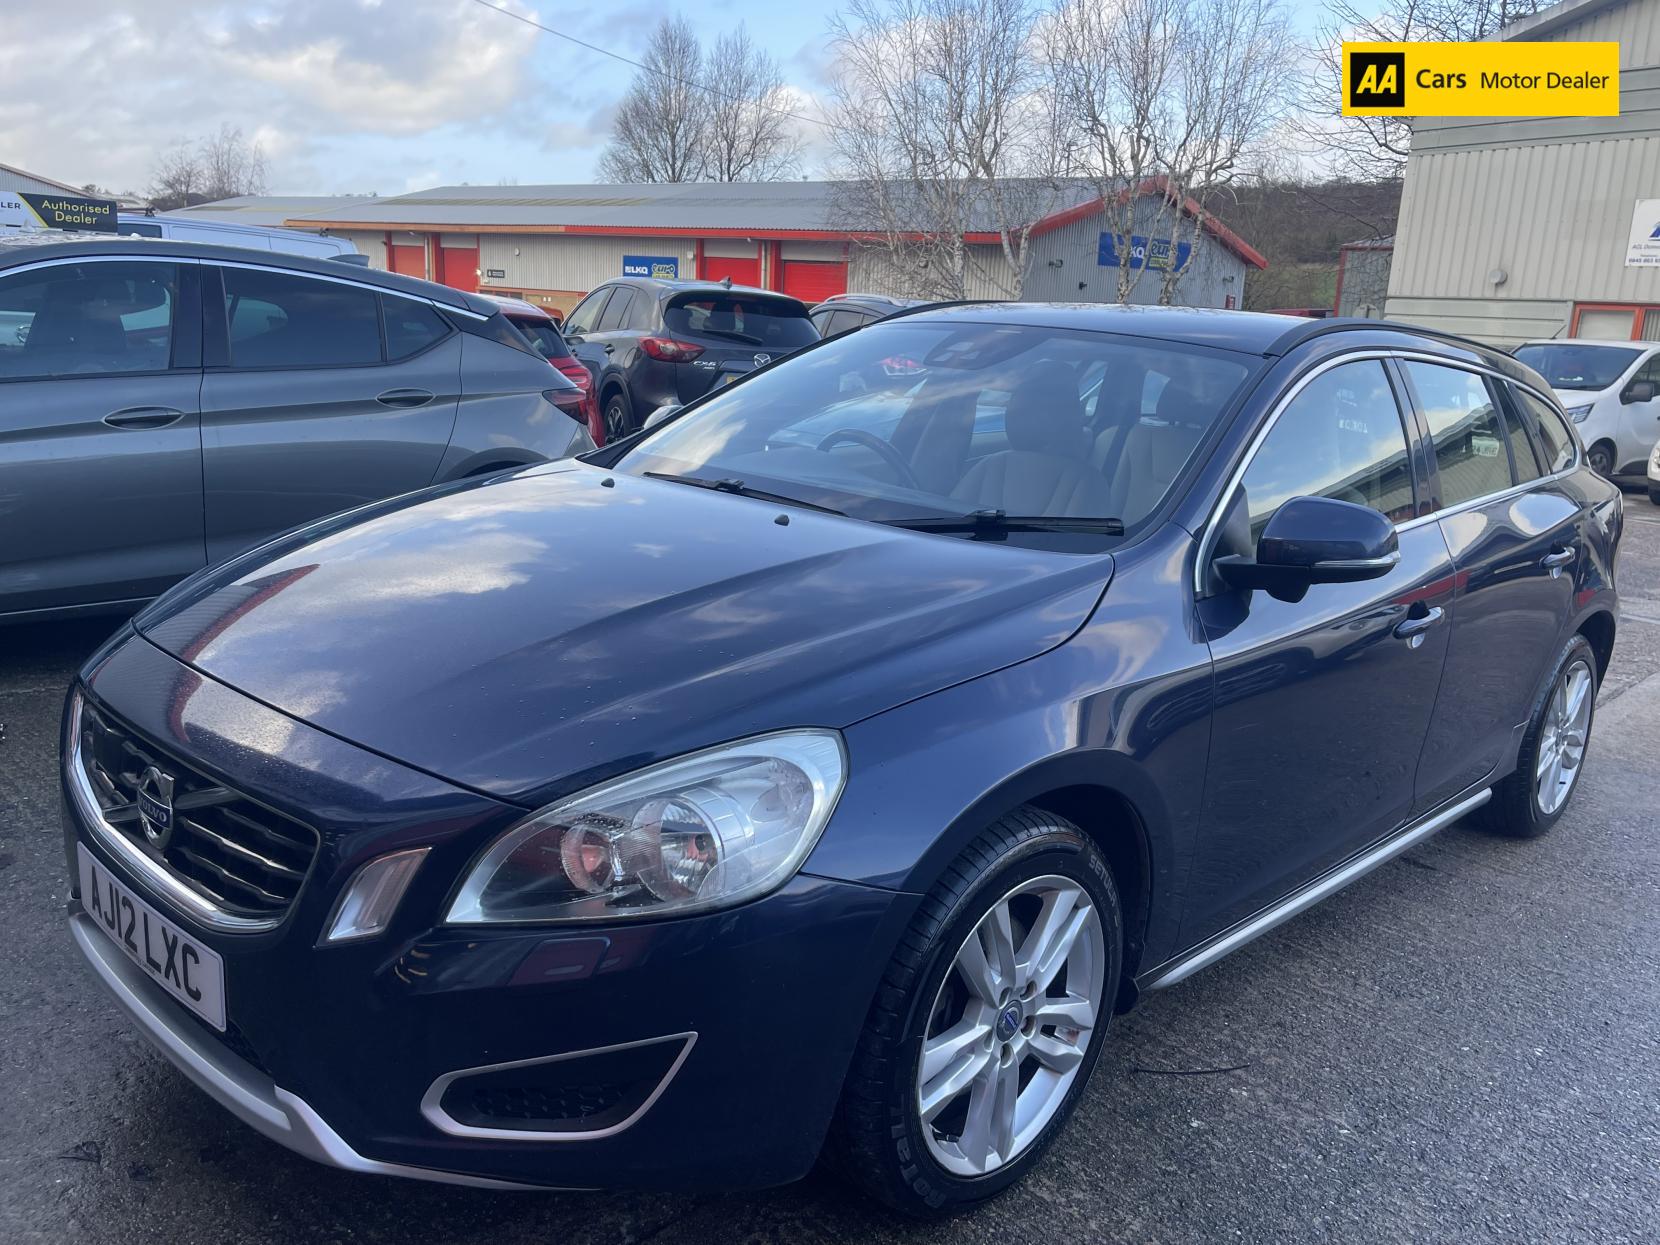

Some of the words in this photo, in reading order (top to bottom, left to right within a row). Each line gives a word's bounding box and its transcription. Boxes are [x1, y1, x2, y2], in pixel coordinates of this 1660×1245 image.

[42, 199, 110, 214] Authorised
[55, 211, 97, 224] Dealer
[138, 795, 167, 822] VOLVO
[91, 864, 138, 953] AJ12
[143, 911, 202, 1002] LXC
